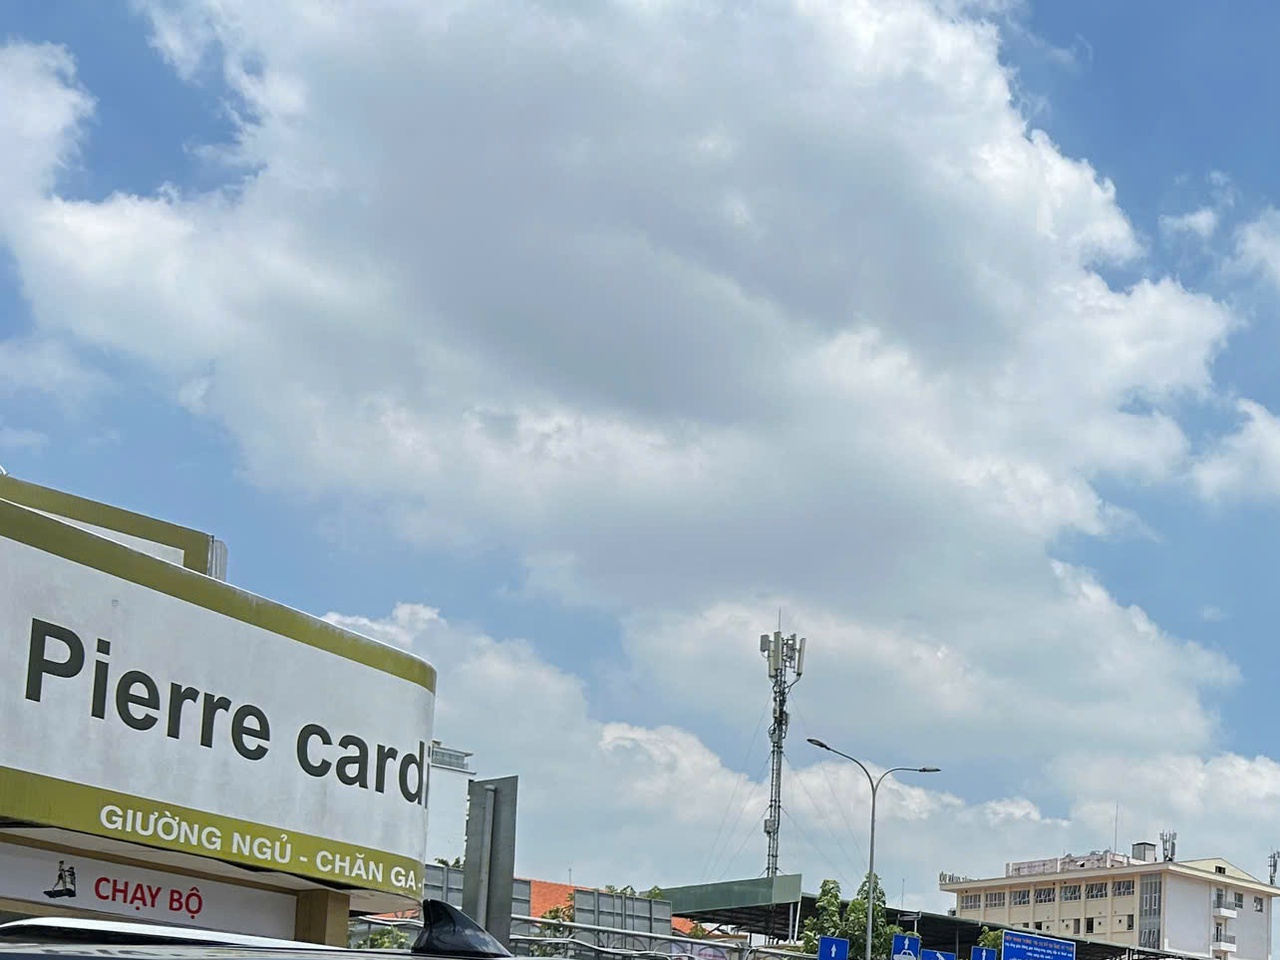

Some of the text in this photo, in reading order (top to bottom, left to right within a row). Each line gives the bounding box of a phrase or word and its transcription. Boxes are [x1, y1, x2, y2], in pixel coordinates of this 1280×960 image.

[25, 617, 271, 761] Pierre
[99, 804, 223, 851] GIƯỜNG
[231, 832, 293, 864] NGỦ
[316, 850, 384, 883] CHĂN
[390, 866, 417, 891] GA
[94, 876, 204, 920] CHẠY BỘ
